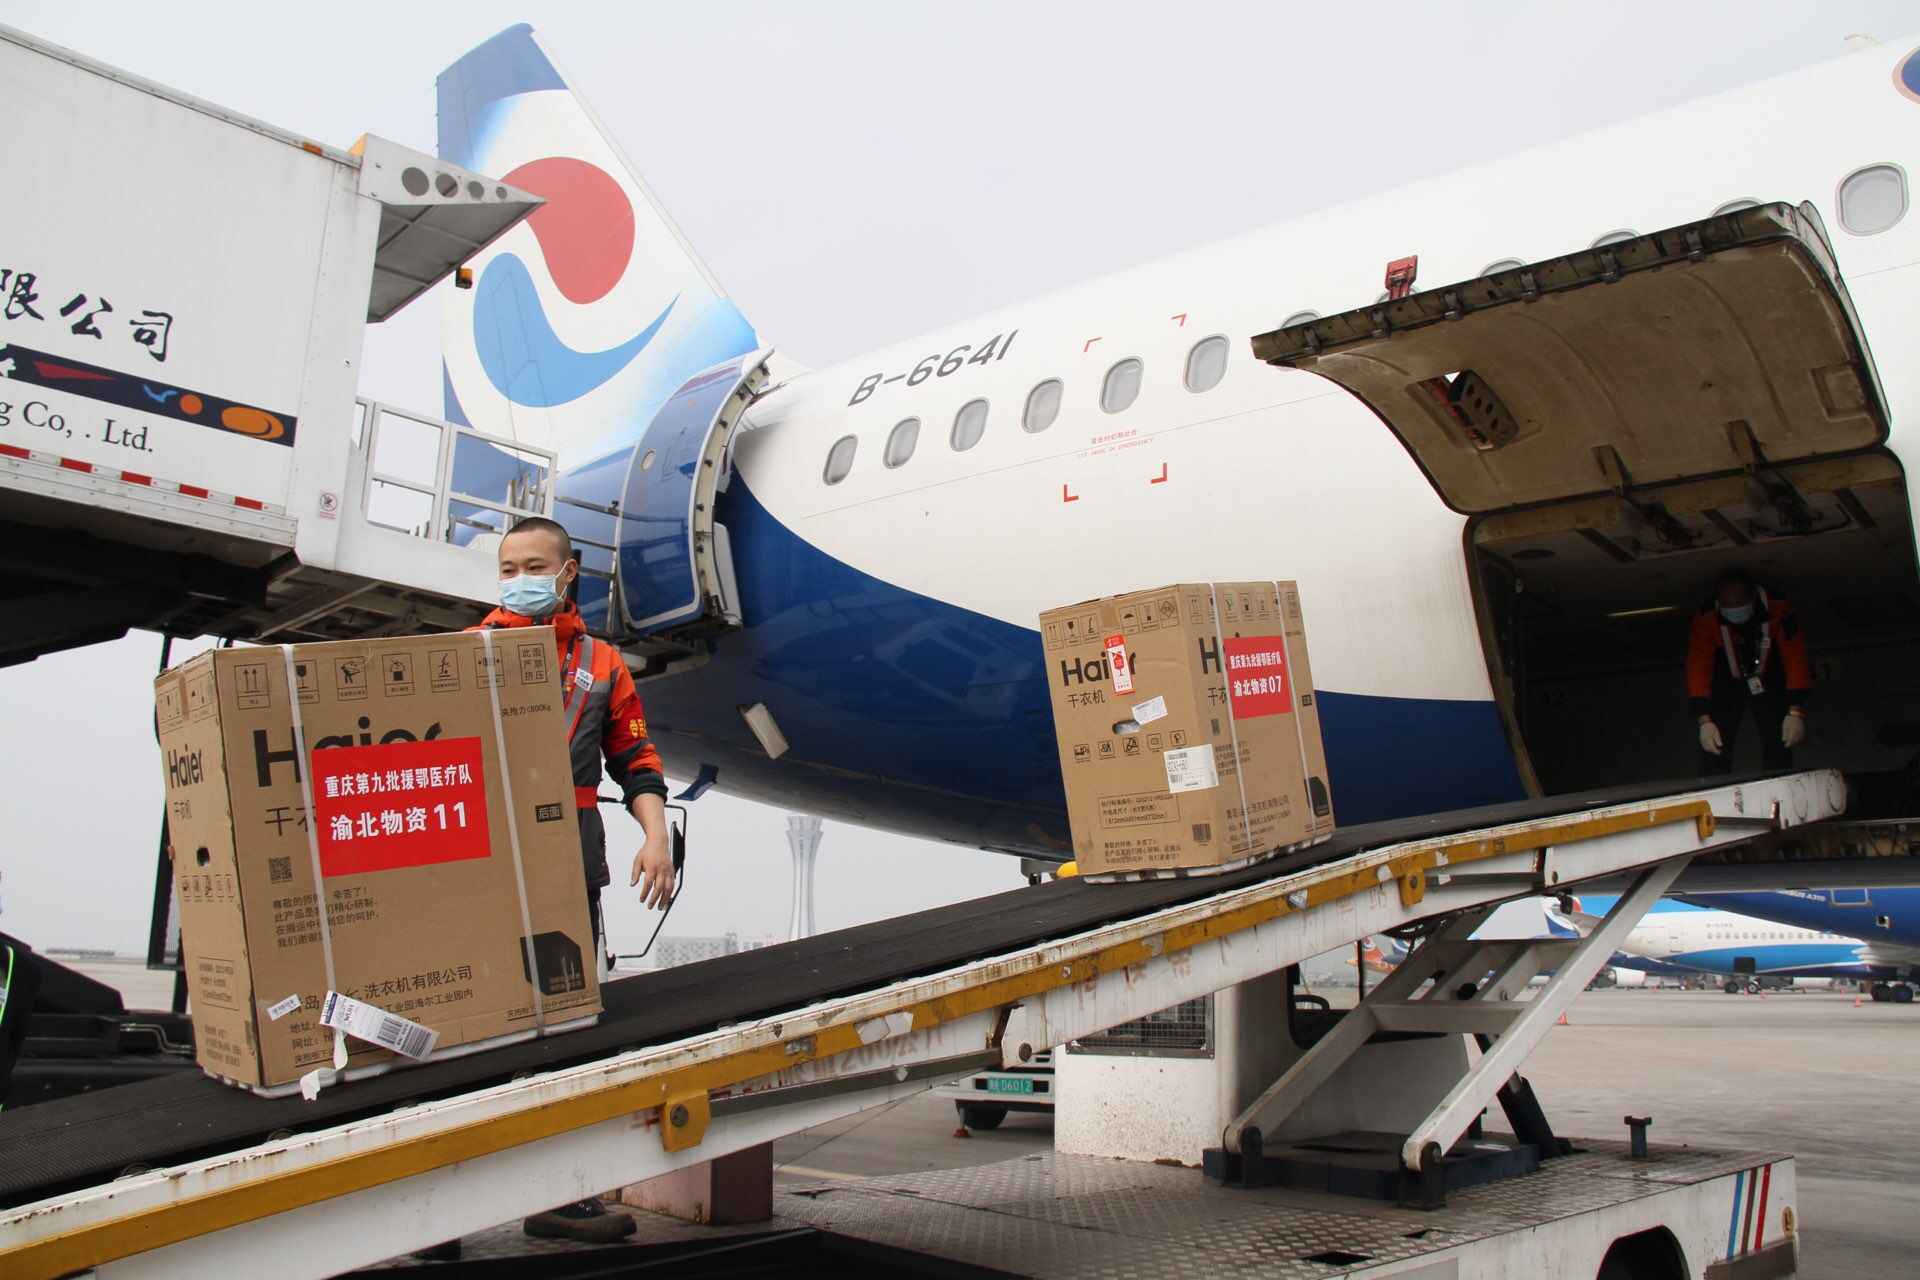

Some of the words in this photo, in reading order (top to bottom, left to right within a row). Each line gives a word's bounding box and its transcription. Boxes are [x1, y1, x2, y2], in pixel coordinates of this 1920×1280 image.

[848, 329, 1018, 407] B-6641
[102, 418, 154, 453] Ltd.
[1061, 651, 1137, 688] Hair
[167, 743, 204, 790] Haier
[324, 762, 473, 798] 重庆第九批援鄂医疗队
